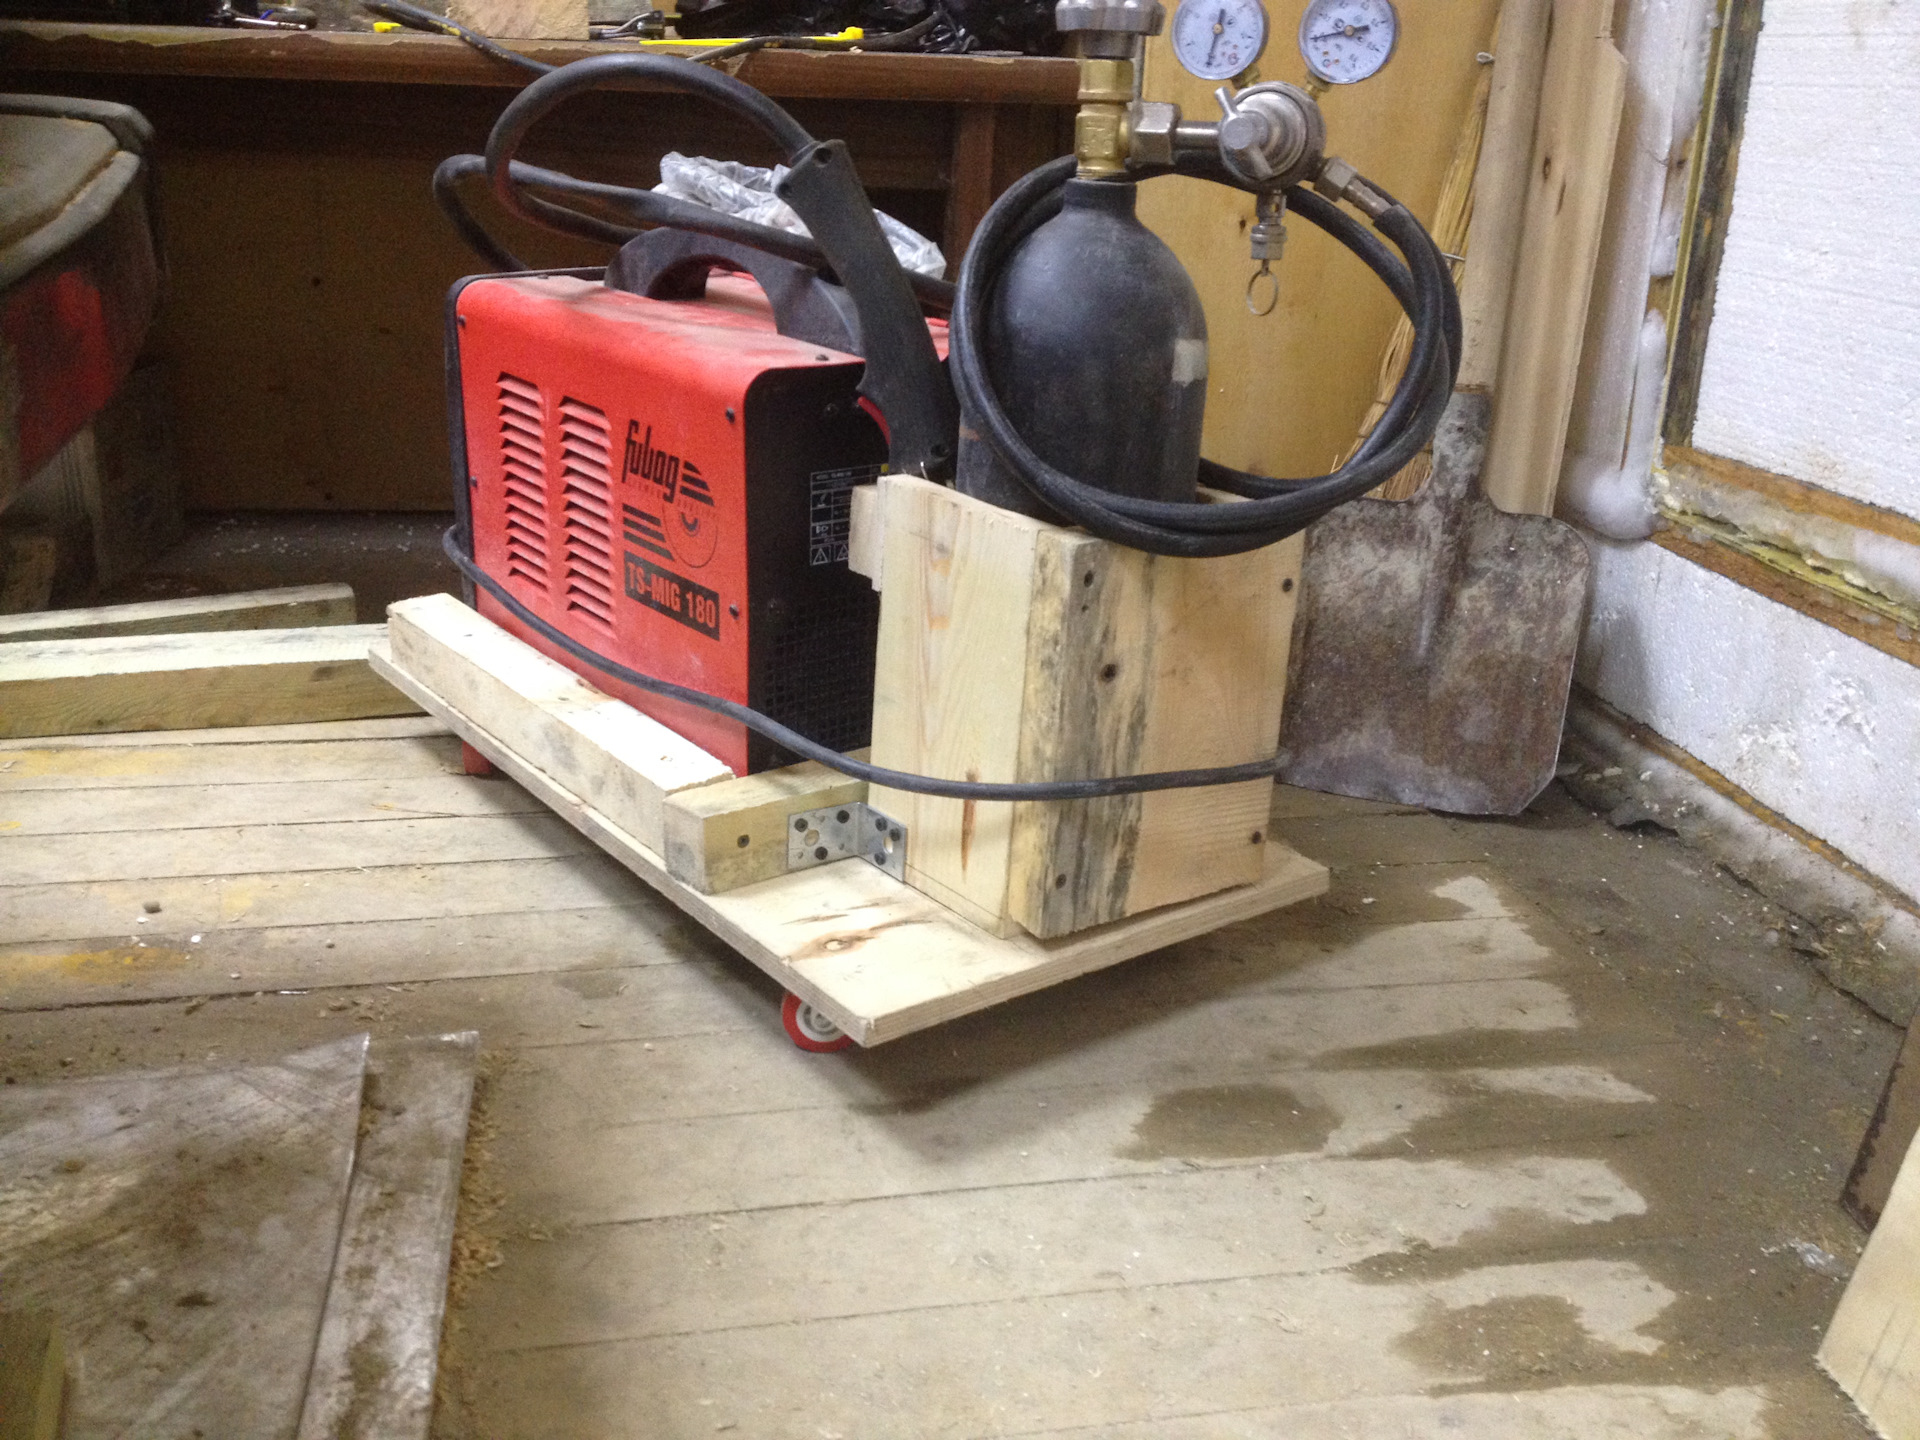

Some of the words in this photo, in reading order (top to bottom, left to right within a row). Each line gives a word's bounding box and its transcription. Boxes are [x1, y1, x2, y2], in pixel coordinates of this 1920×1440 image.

[622, 419, 680, 503] fubag
[627, 562, 681, 612] TS-MIG
[685, 591, 716, 629] 180
